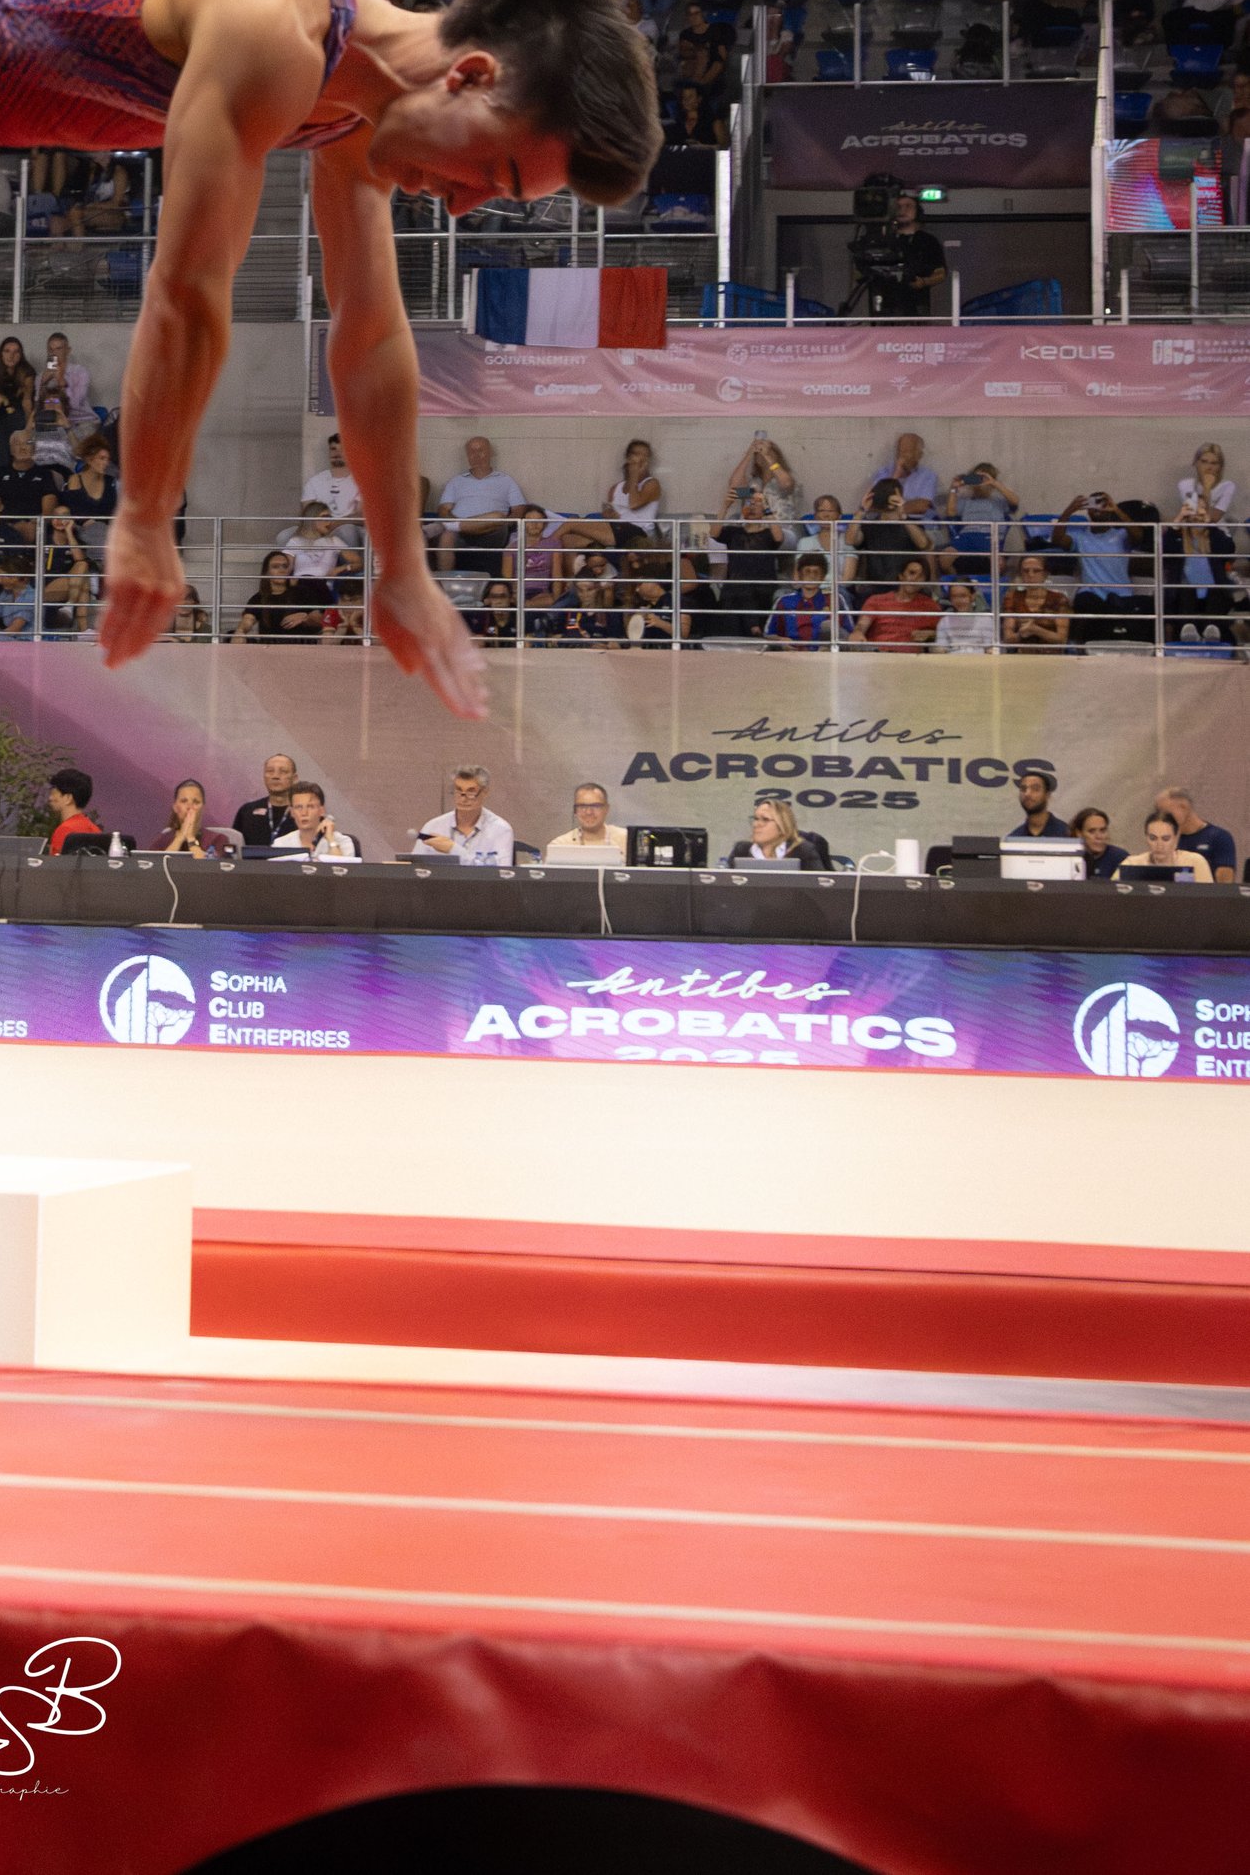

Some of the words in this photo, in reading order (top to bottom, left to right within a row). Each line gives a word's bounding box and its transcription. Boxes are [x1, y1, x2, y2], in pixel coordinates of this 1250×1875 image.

[841, 133, 1029, 149] ACROBATICS
[712, 716, 962, 745] Antibes
[621, 751, 1058, 792] ACROBATICS
[754, 788, 921, 810] 2025
[566, 966, 851, 1001] Antibes
[464, 1003, 958, 1058] ACROBATICS
